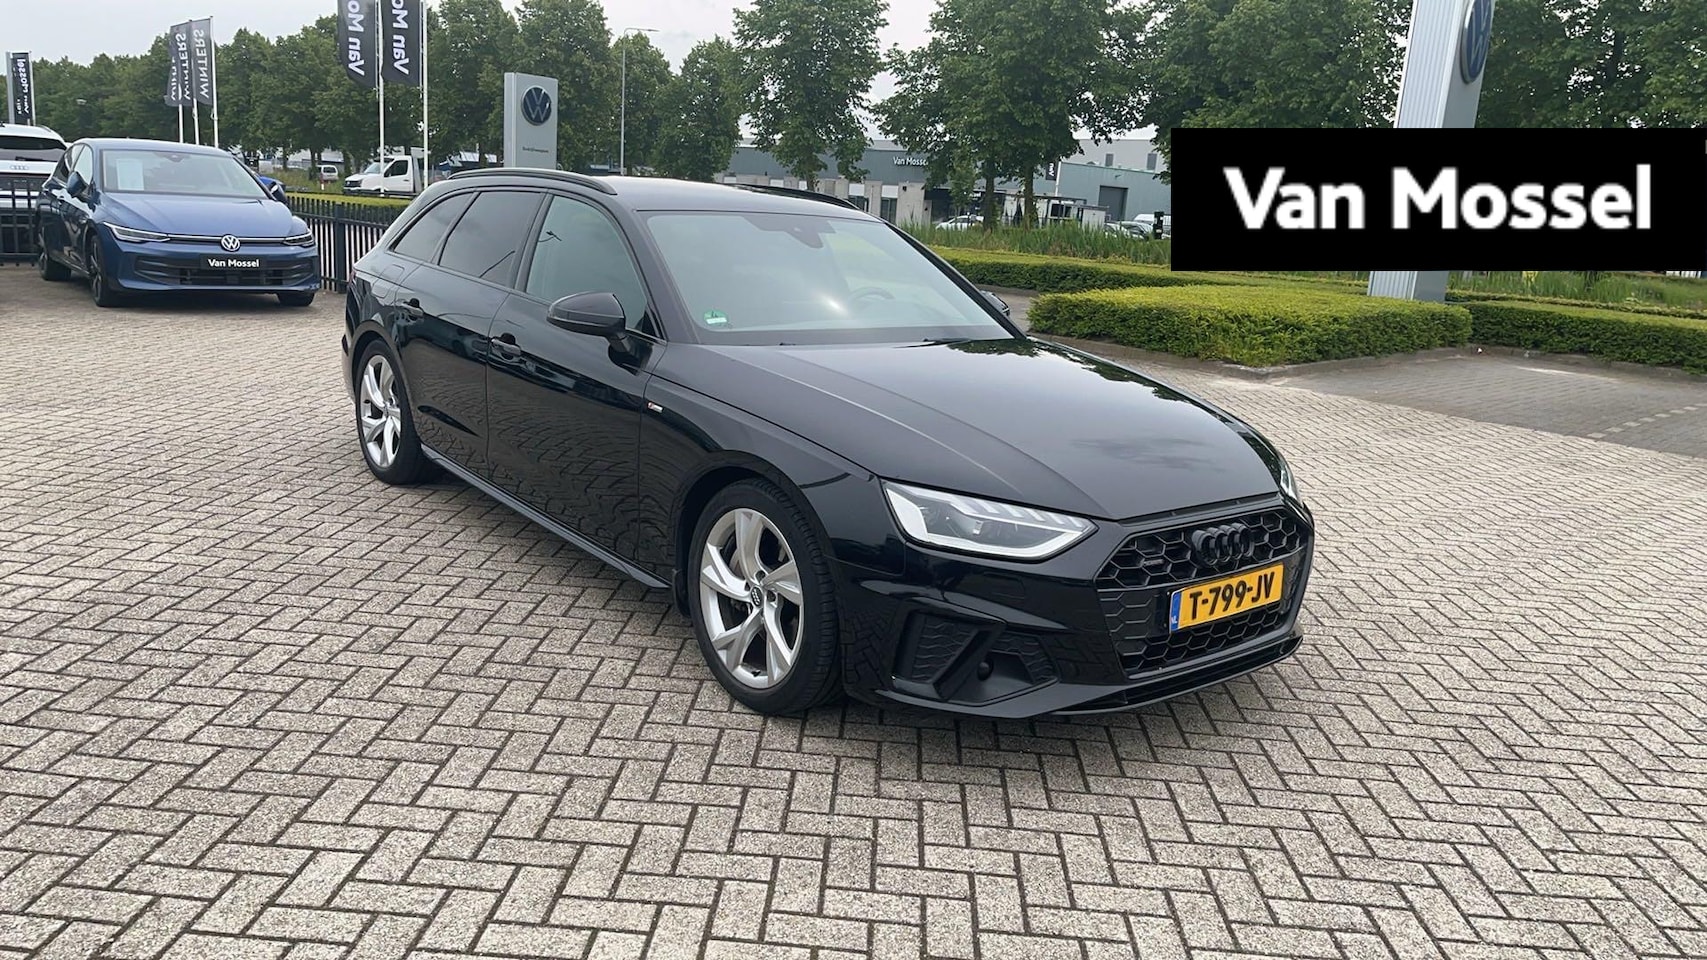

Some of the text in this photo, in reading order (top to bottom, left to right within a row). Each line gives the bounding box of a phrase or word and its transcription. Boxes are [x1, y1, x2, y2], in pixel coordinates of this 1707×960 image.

[893, 156, 905, 165] Van
[208, 258, 260, 267] Van Mossel
[1189, 571, 1275, 620] T-799-JV
